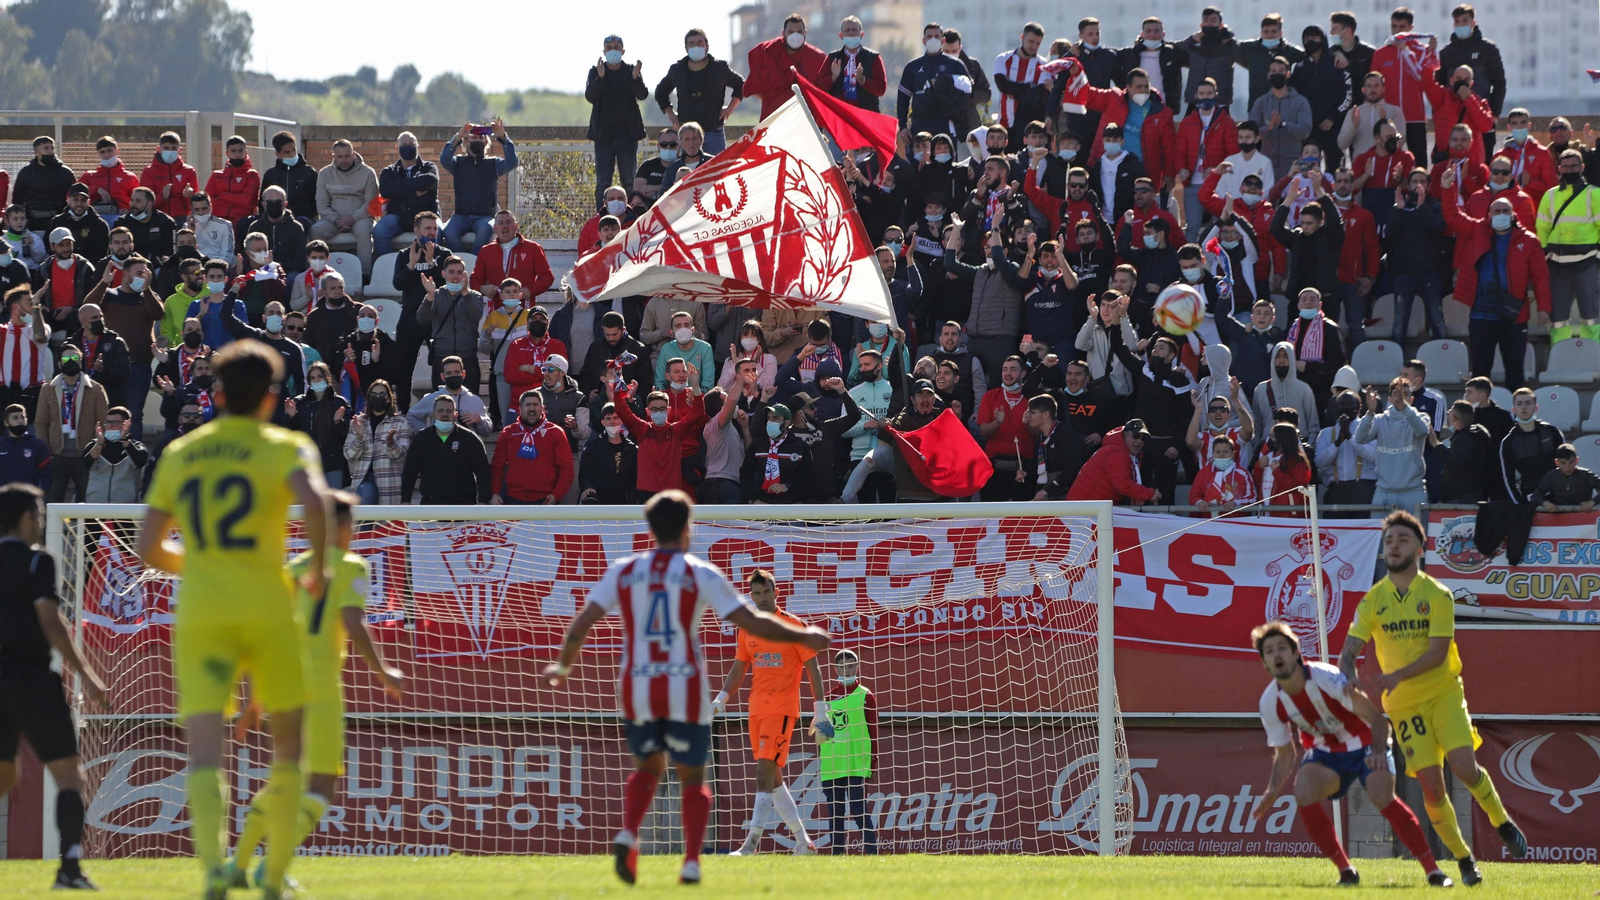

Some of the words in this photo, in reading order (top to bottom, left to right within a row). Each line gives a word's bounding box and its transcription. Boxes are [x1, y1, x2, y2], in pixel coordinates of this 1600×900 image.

[1068, 402, 1096, 417] EA7
[178, 474, 257, 550] 12
[541, 516, 1238, 617] AGECIRAS
[644, 590, 677, 646] 4
[896, 604, 986, 627] FONDO
[1398, 714, 1427, 743] 28
[237, 745, 582, 800] HUNDAI
[235, 804, 586, 833] PRMOTOR
[899, 836, 941, 853] Integral
[946, 839, 960, 850] en
[964, 837, 1023, 853] transporte
[1142, 838, 1195, 854] Logística
[1198, 839, 1243, 855] Integral
[1246, 842, 1261, 852] en
[1501, 845, 1588, 861] PRMOTOR
